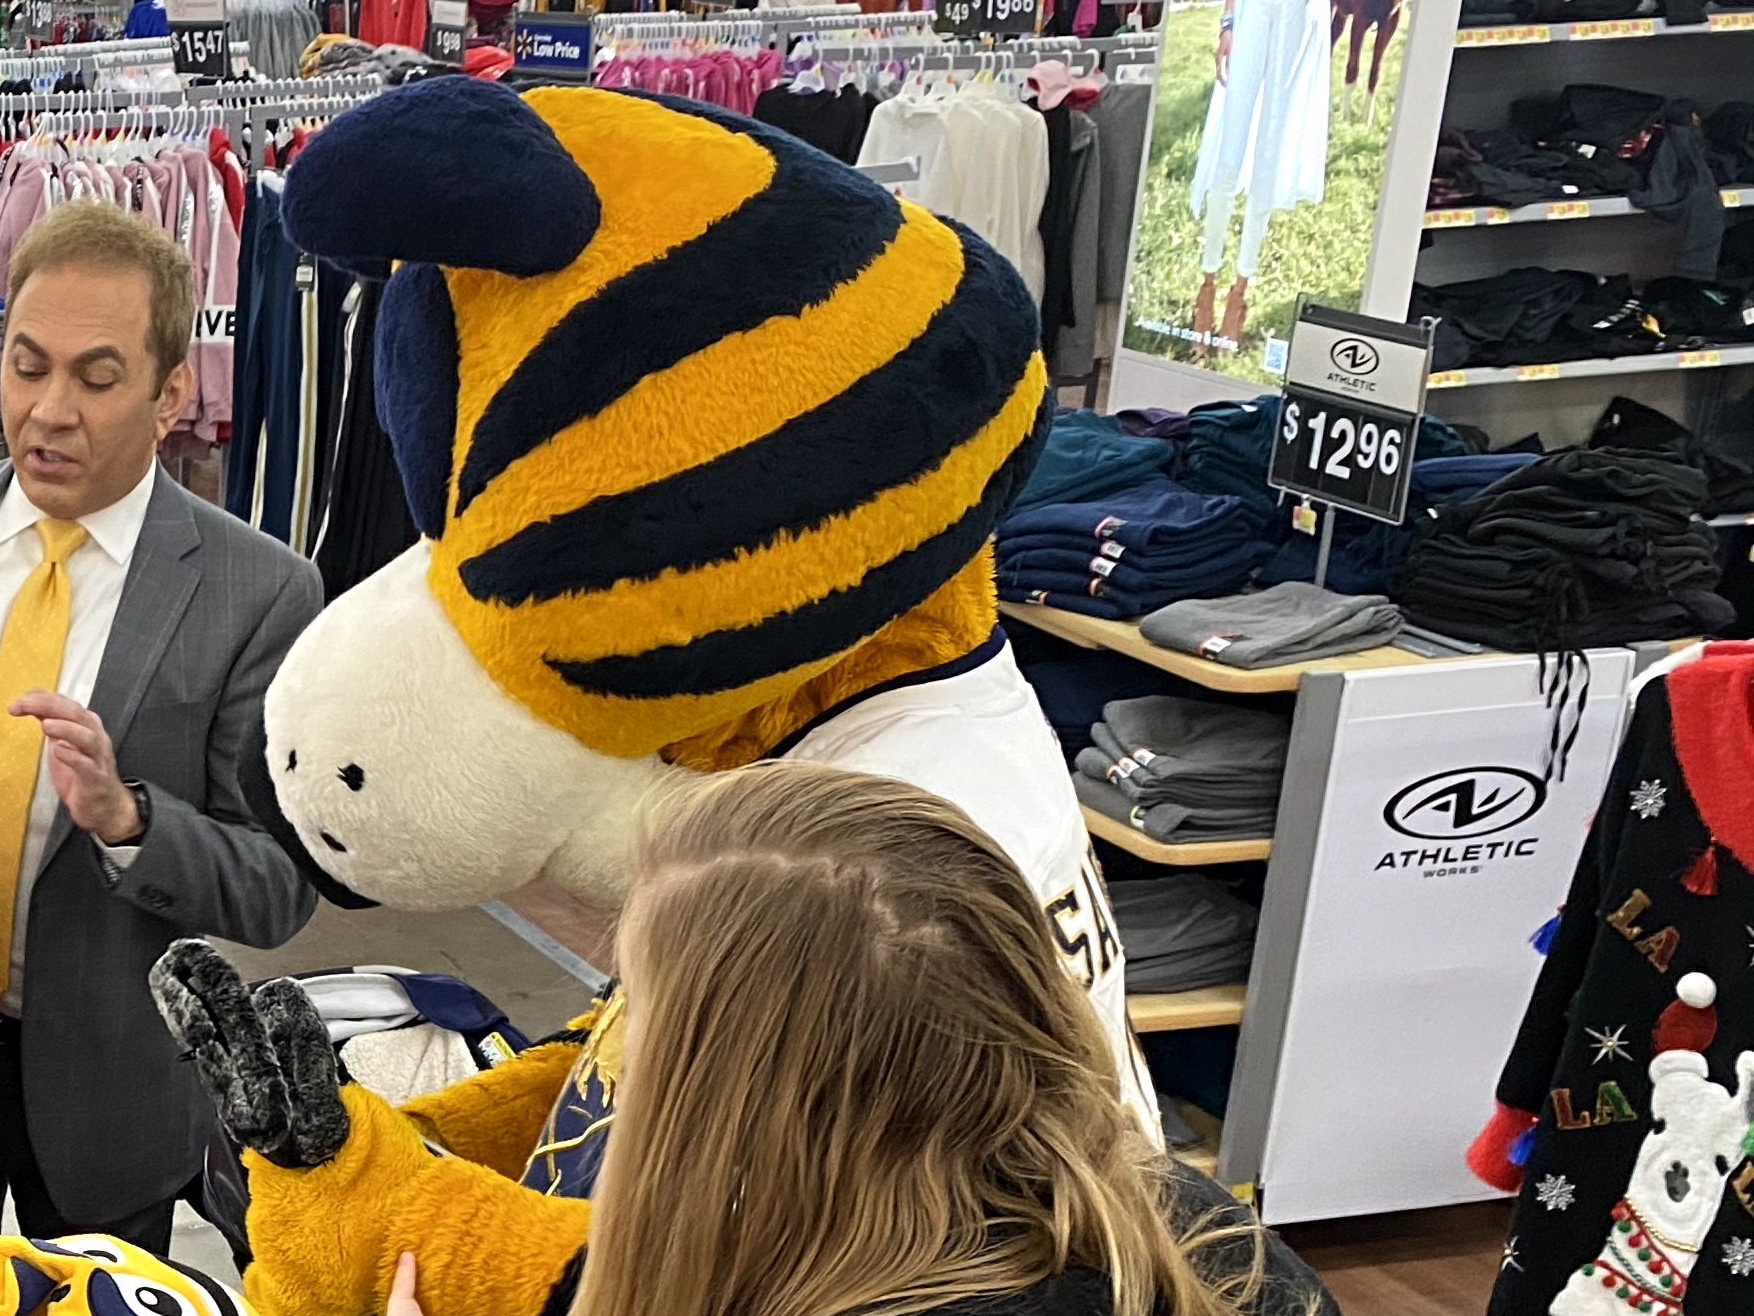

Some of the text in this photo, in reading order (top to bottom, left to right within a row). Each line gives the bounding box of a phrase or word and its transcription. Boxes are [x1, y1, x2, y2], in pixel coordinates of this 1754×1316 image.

[945, 3, 969, 25] $49
[171, 30, 224, 63] $1547
[533, 41, 580, 59] Low Price
[1327, 372, 1377, 392] ATHLETIC
[1374, 838, 1539, 871] ATHLETIC
[1607, 888, 1681, 974] LA
[1550, 1080, 1638, 1130] LA
